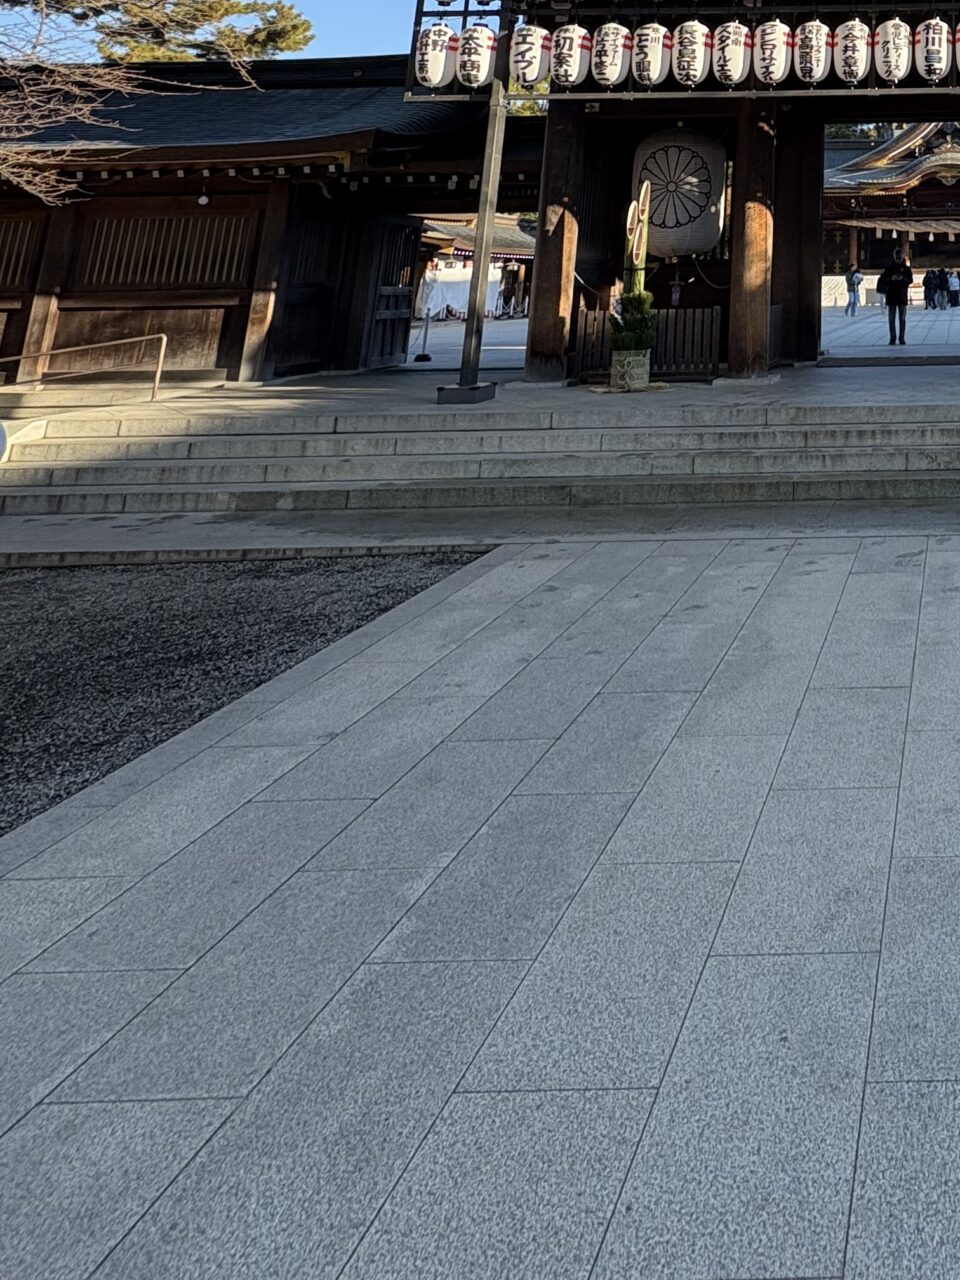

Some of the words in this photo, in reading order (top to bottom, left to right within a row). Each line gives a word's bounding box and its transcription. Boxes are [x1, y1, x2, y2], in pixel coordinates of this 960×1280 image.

[881, 40, 893, 77] クリニック
